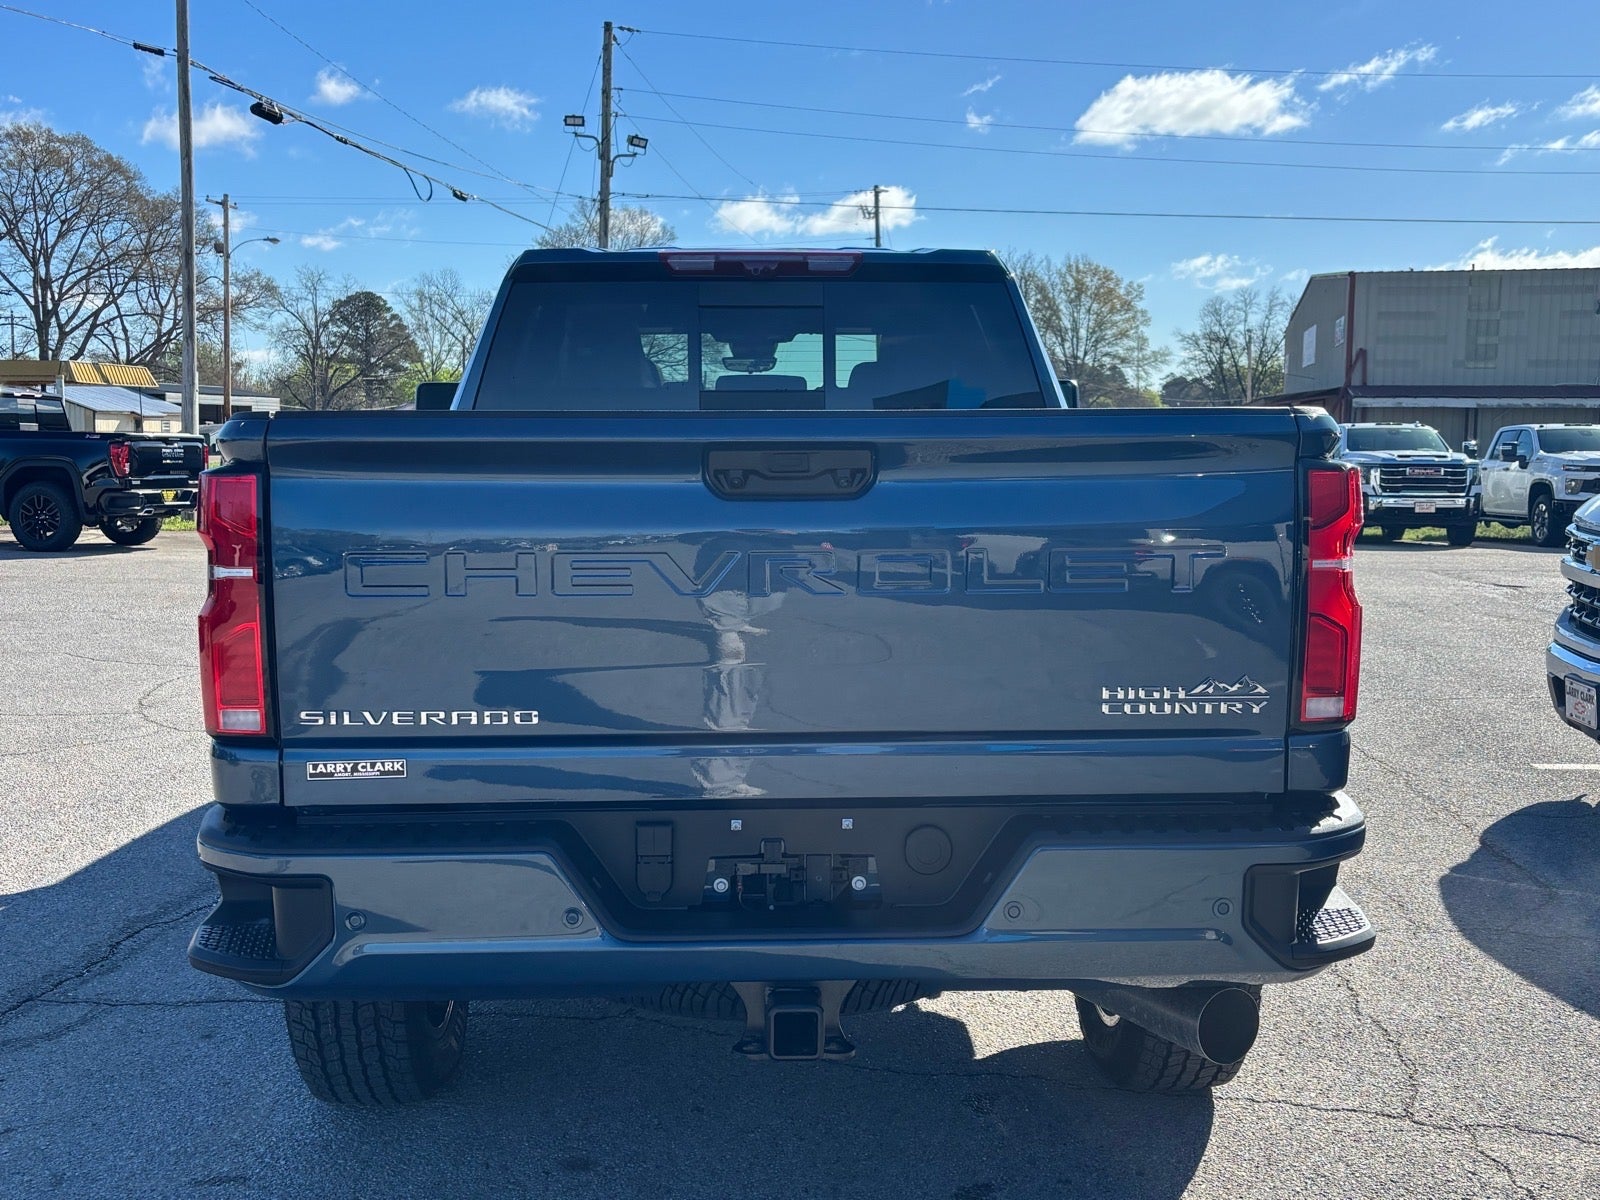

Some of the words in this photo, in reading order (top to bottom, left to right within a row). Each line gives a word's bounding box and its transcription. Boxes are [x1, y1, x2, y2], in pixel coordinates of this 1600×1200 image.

[345, 544, 1226, 596] CHEVROLET
[1102, 686, 1186, 699] HIGH
[1102, 701, 1268, 715] COUNTRY
[299, 710, 540, 726] SILVERADO
[309, 763, 353, 773] LARRY
[357, 761, 404, 771] CLARK
